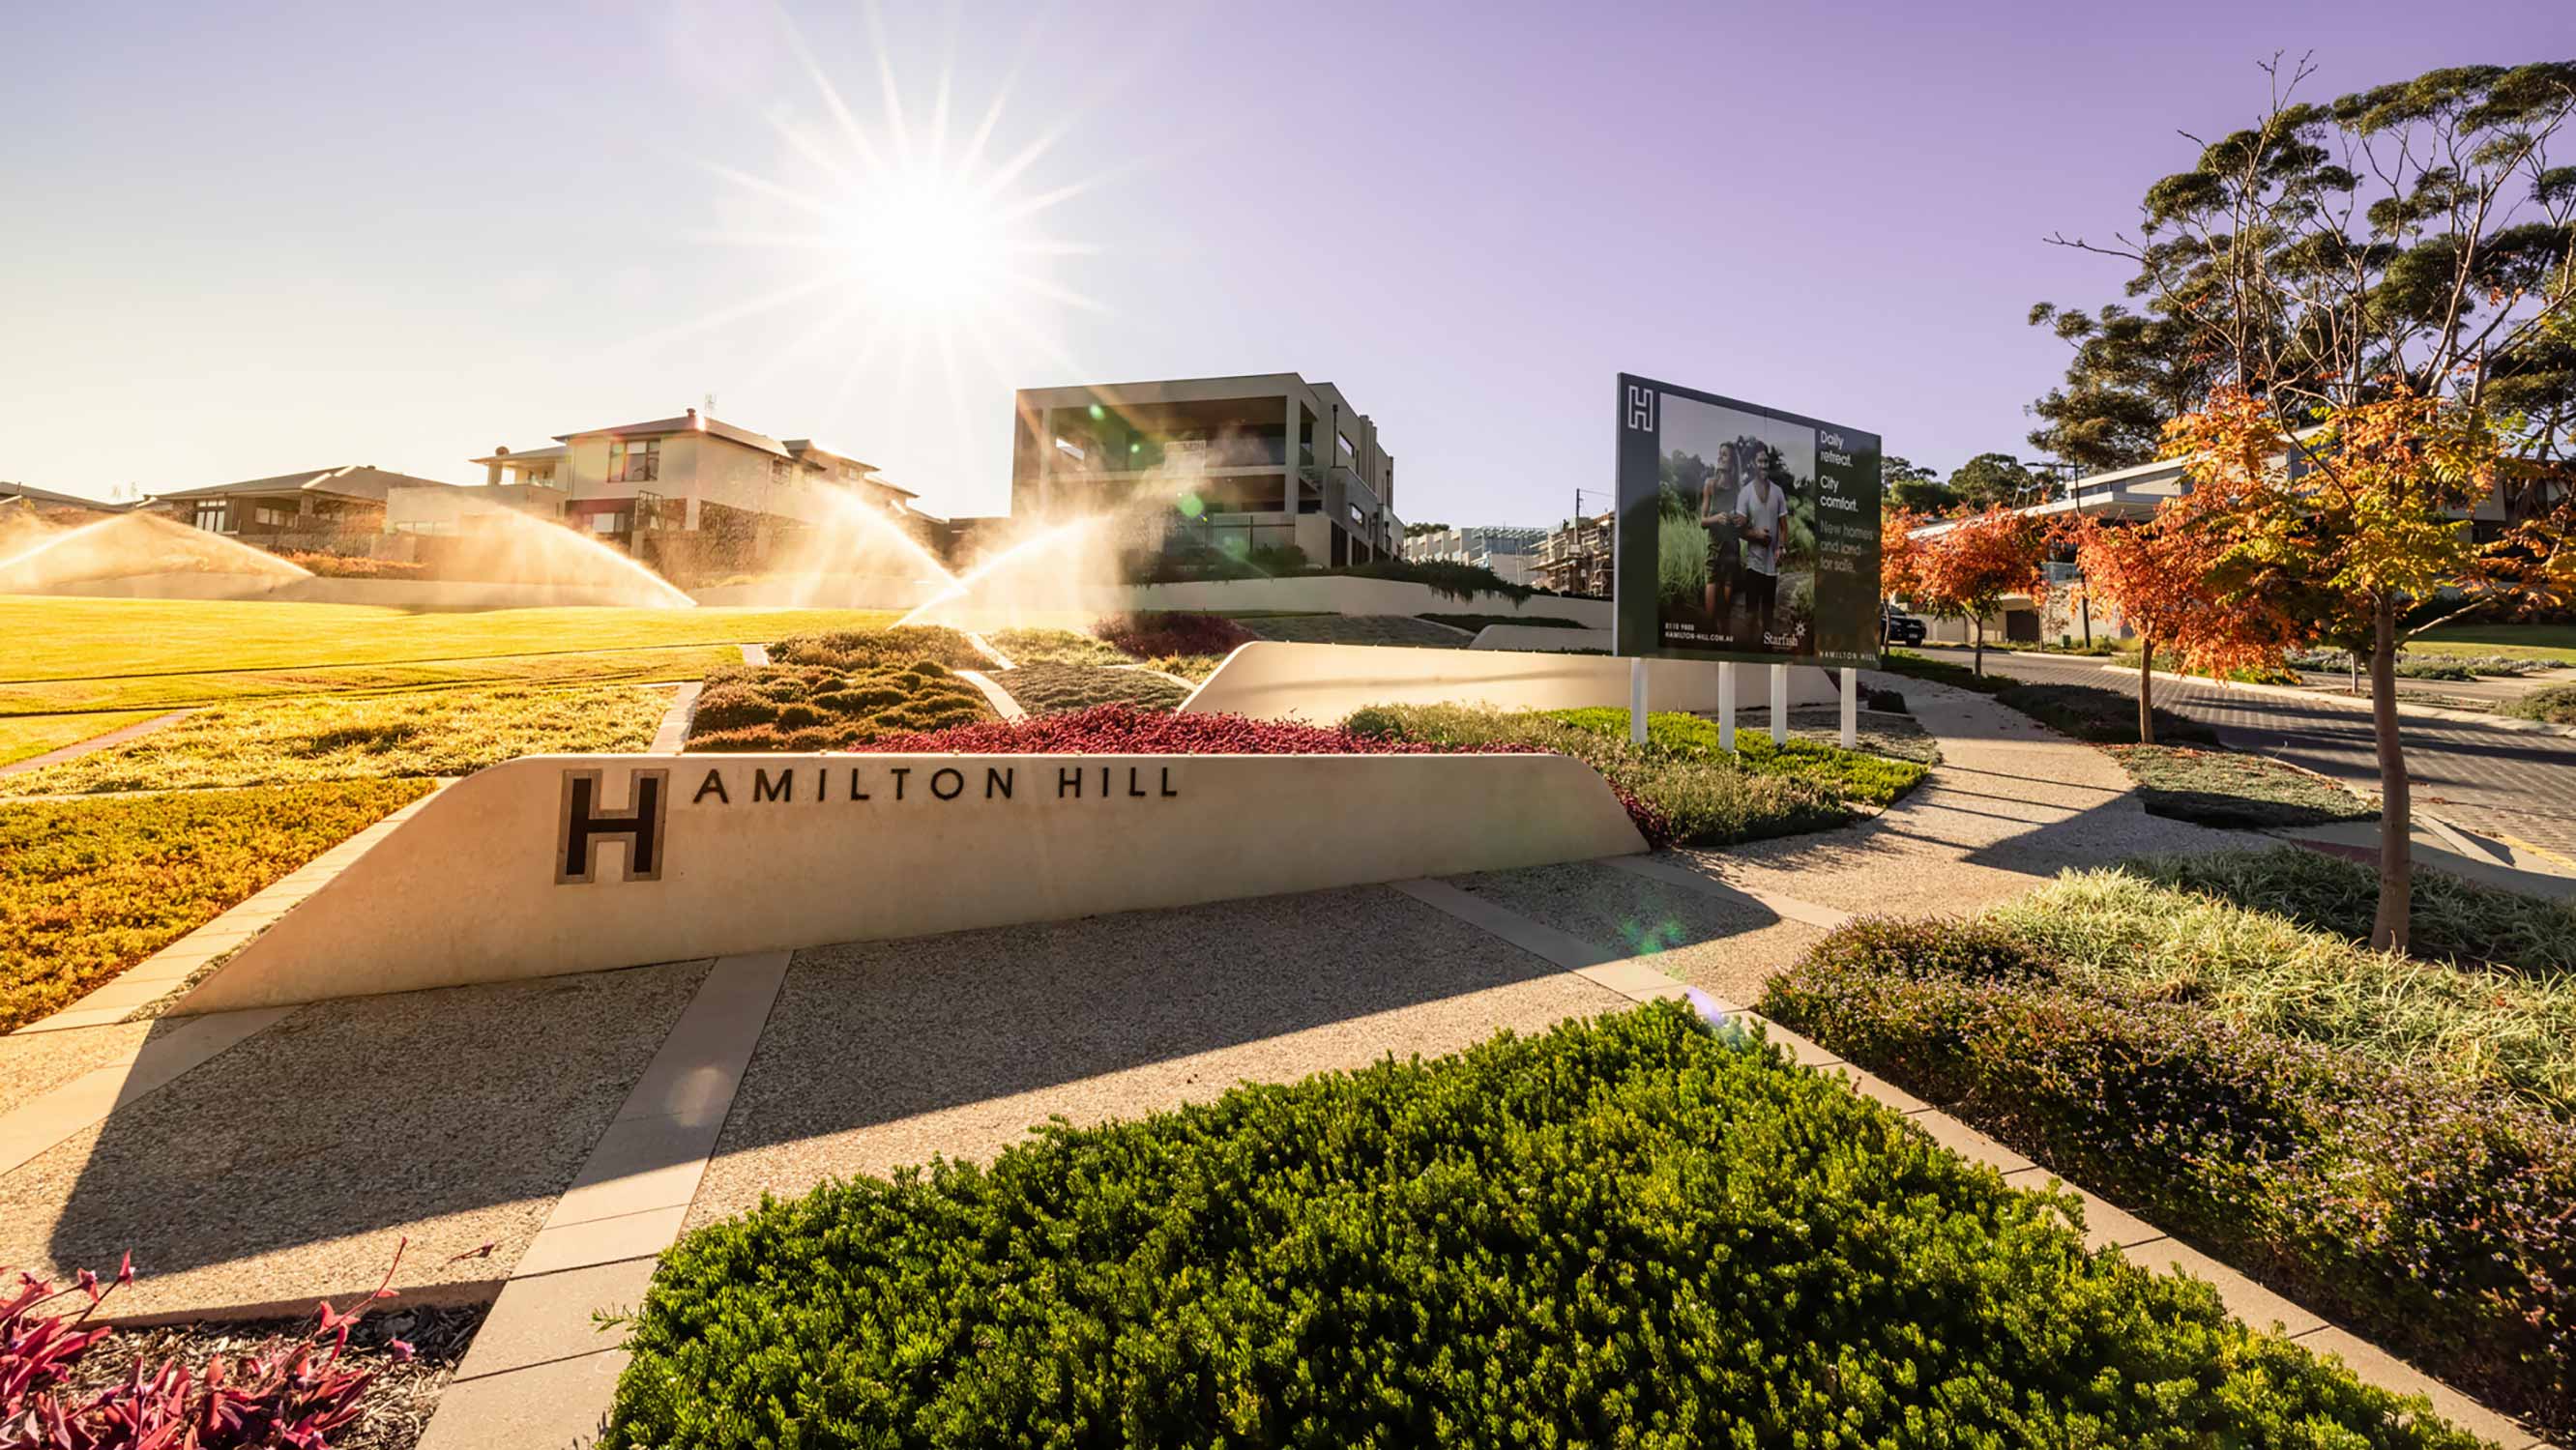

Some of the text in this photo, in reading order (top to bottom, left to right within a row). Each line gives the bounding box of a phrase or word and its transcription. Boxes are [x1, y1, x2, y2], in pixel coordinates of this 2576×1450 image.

[1628, 385, 1654, 432] H
[1821, 430, 1844, 450] Daily
[1820, 450, 1853, 468] retreat.
[1820, 475, 1839, 493] City
[1820, 496, 1859, 512] comfort.
[1820, 519, 1873, 540] New homes
[1820, 540, 1861, 557] and land
[1820, 557, 1833, 570] for
[1763, 631, 1799, 647] Starfish
[1819, 651, 1858, 660] HAMILTON
[1059, 767, 1178, 798] HILL
